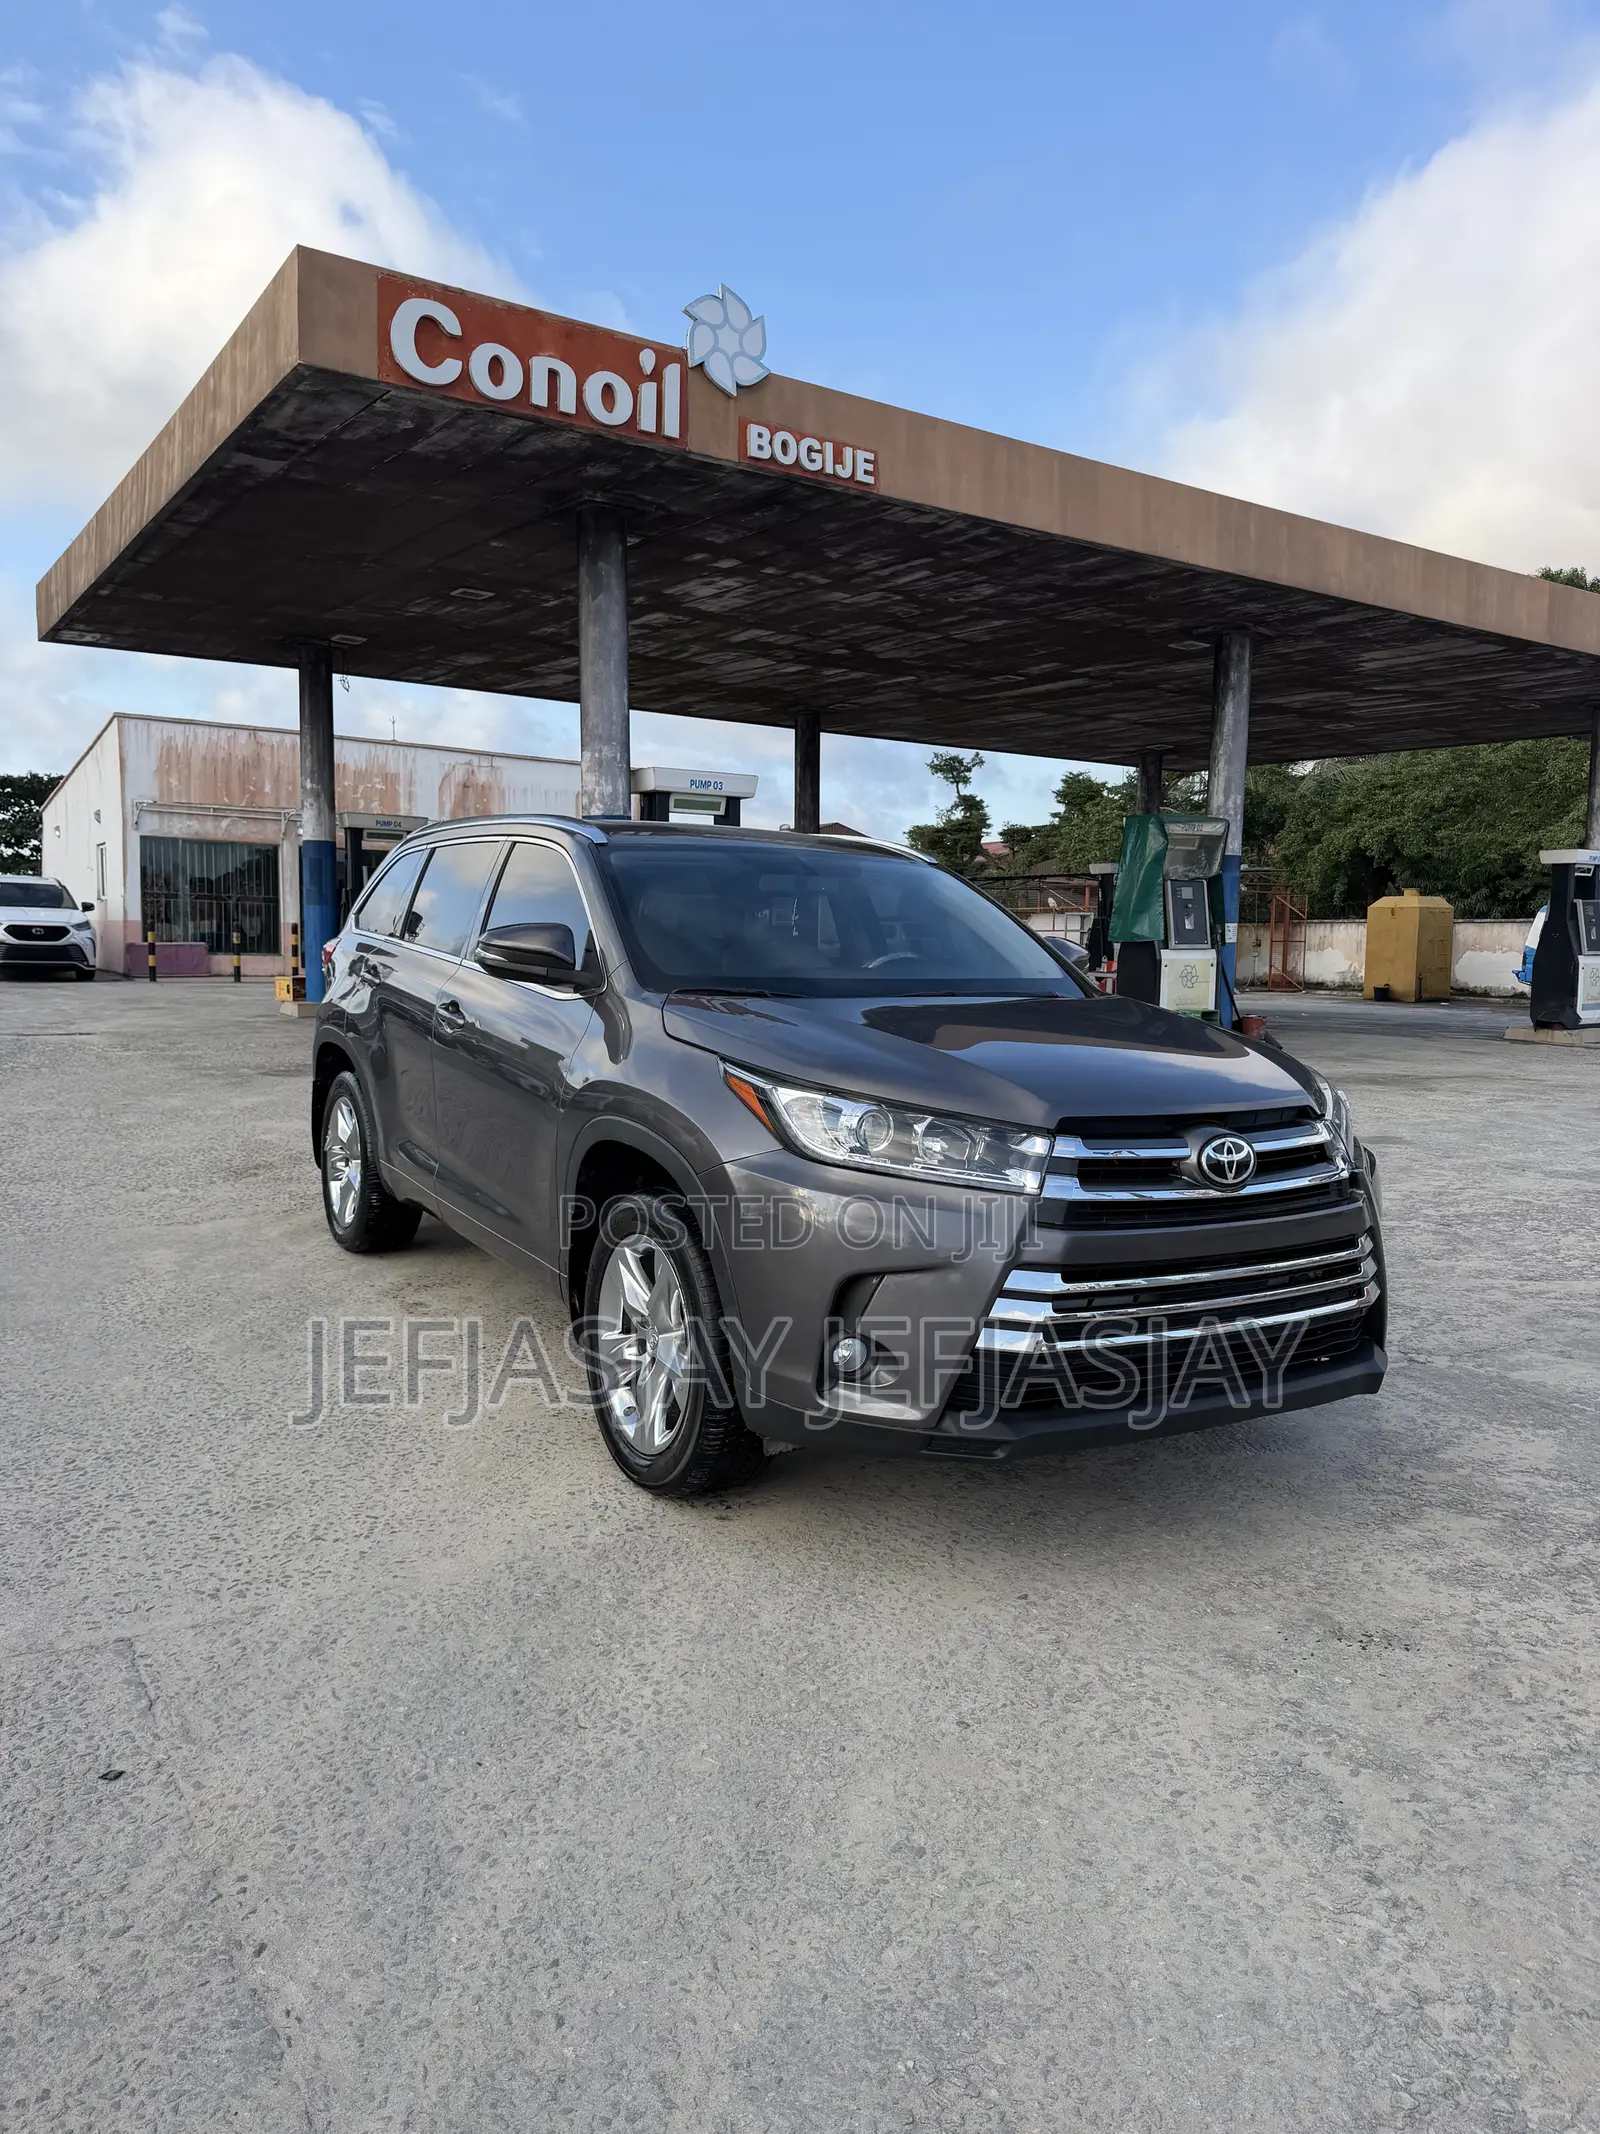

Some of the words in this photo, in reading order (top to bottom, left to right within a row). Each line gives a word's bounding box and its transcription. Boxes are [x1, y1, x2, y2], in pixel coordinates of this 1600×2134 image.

[390, 298, 681, 439] Conoil
[746, 422, 876, 485] BOGIJE
[690, 779, 712, 790] PUMP
[713, 781, 723, 790] 03
[375, 819, 393, 827] PUMP
